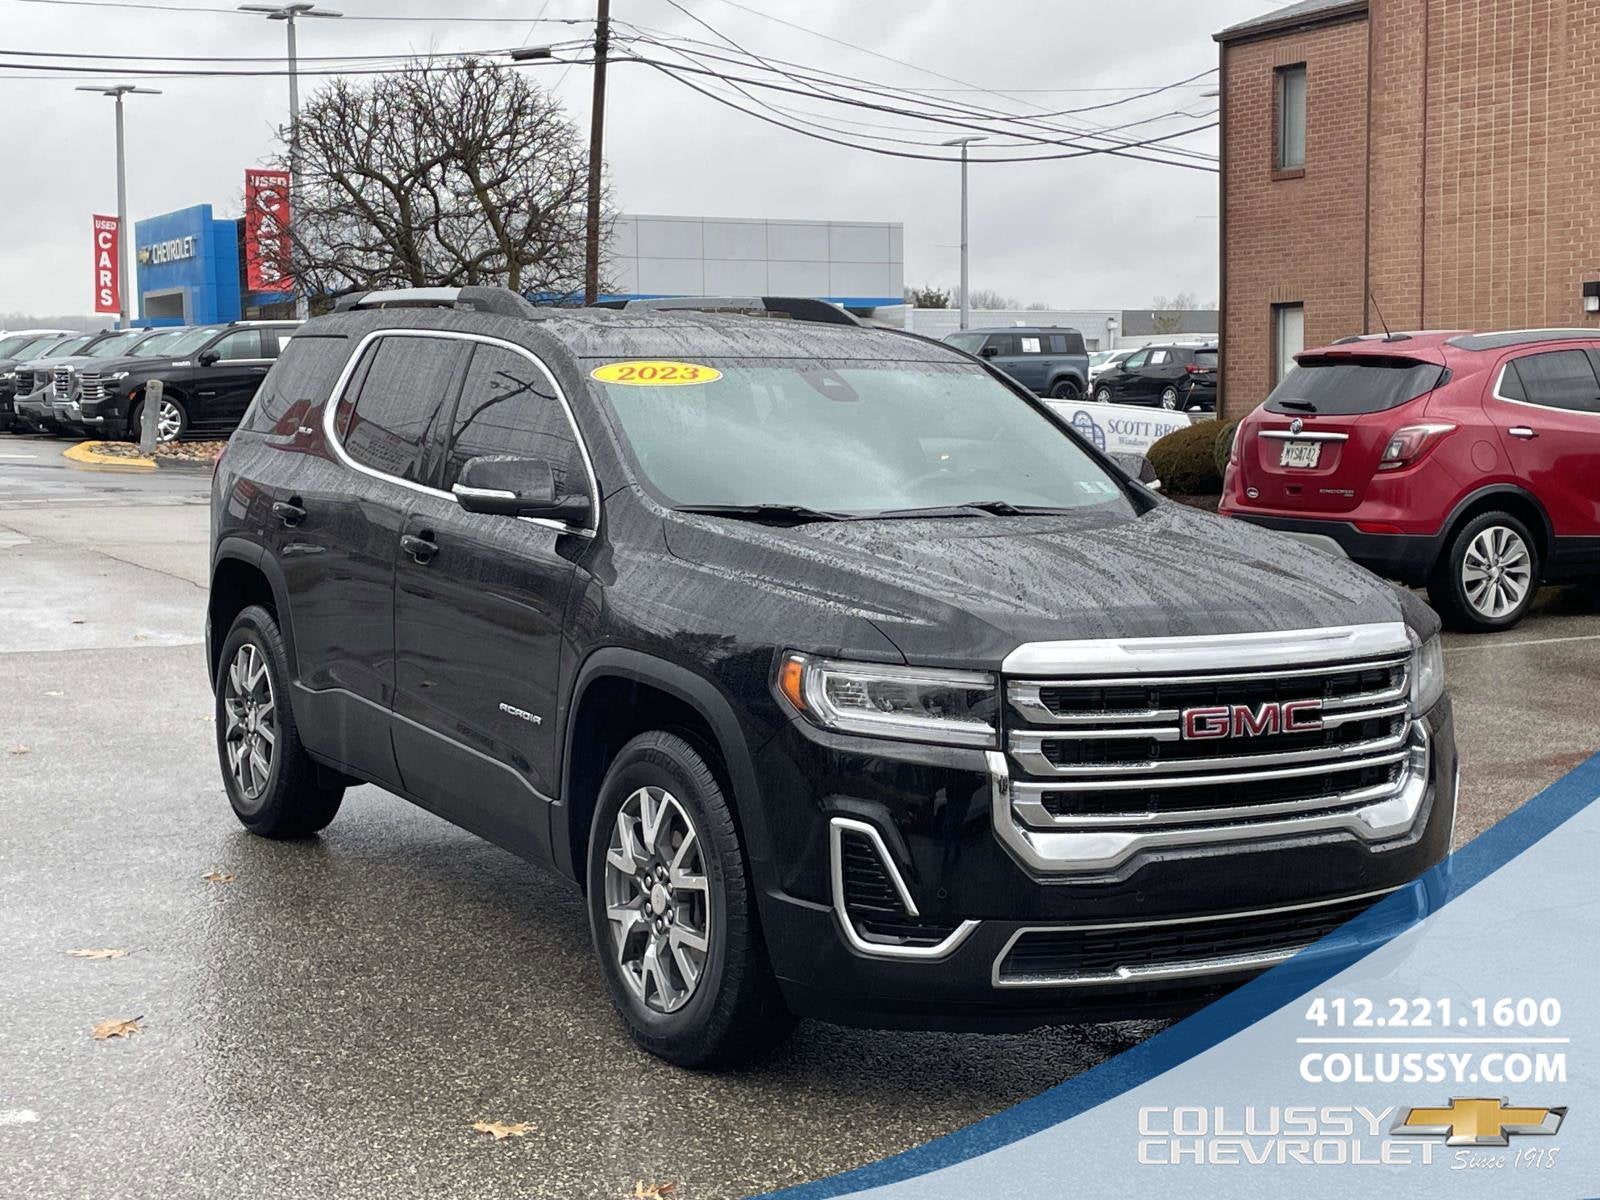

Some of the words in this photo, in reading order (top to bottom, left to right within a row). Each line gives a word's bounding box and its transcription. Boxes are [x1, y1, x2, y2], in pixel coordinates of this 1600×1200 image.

[249, 175, 288, 188] USED
[95, 219, 117, 231] USED
[256, 189, 281, 282] CARS
[152, 235, 194, 265] CHEVROLET
[98, 231, 114, 307] CARS
[617, 365, 700, 381] 2023
[1107, 419, 1153, 437] SCOTT
[499, 702, 542, 726] ACADIA
[1182, 699, 1323, 741] GMC
